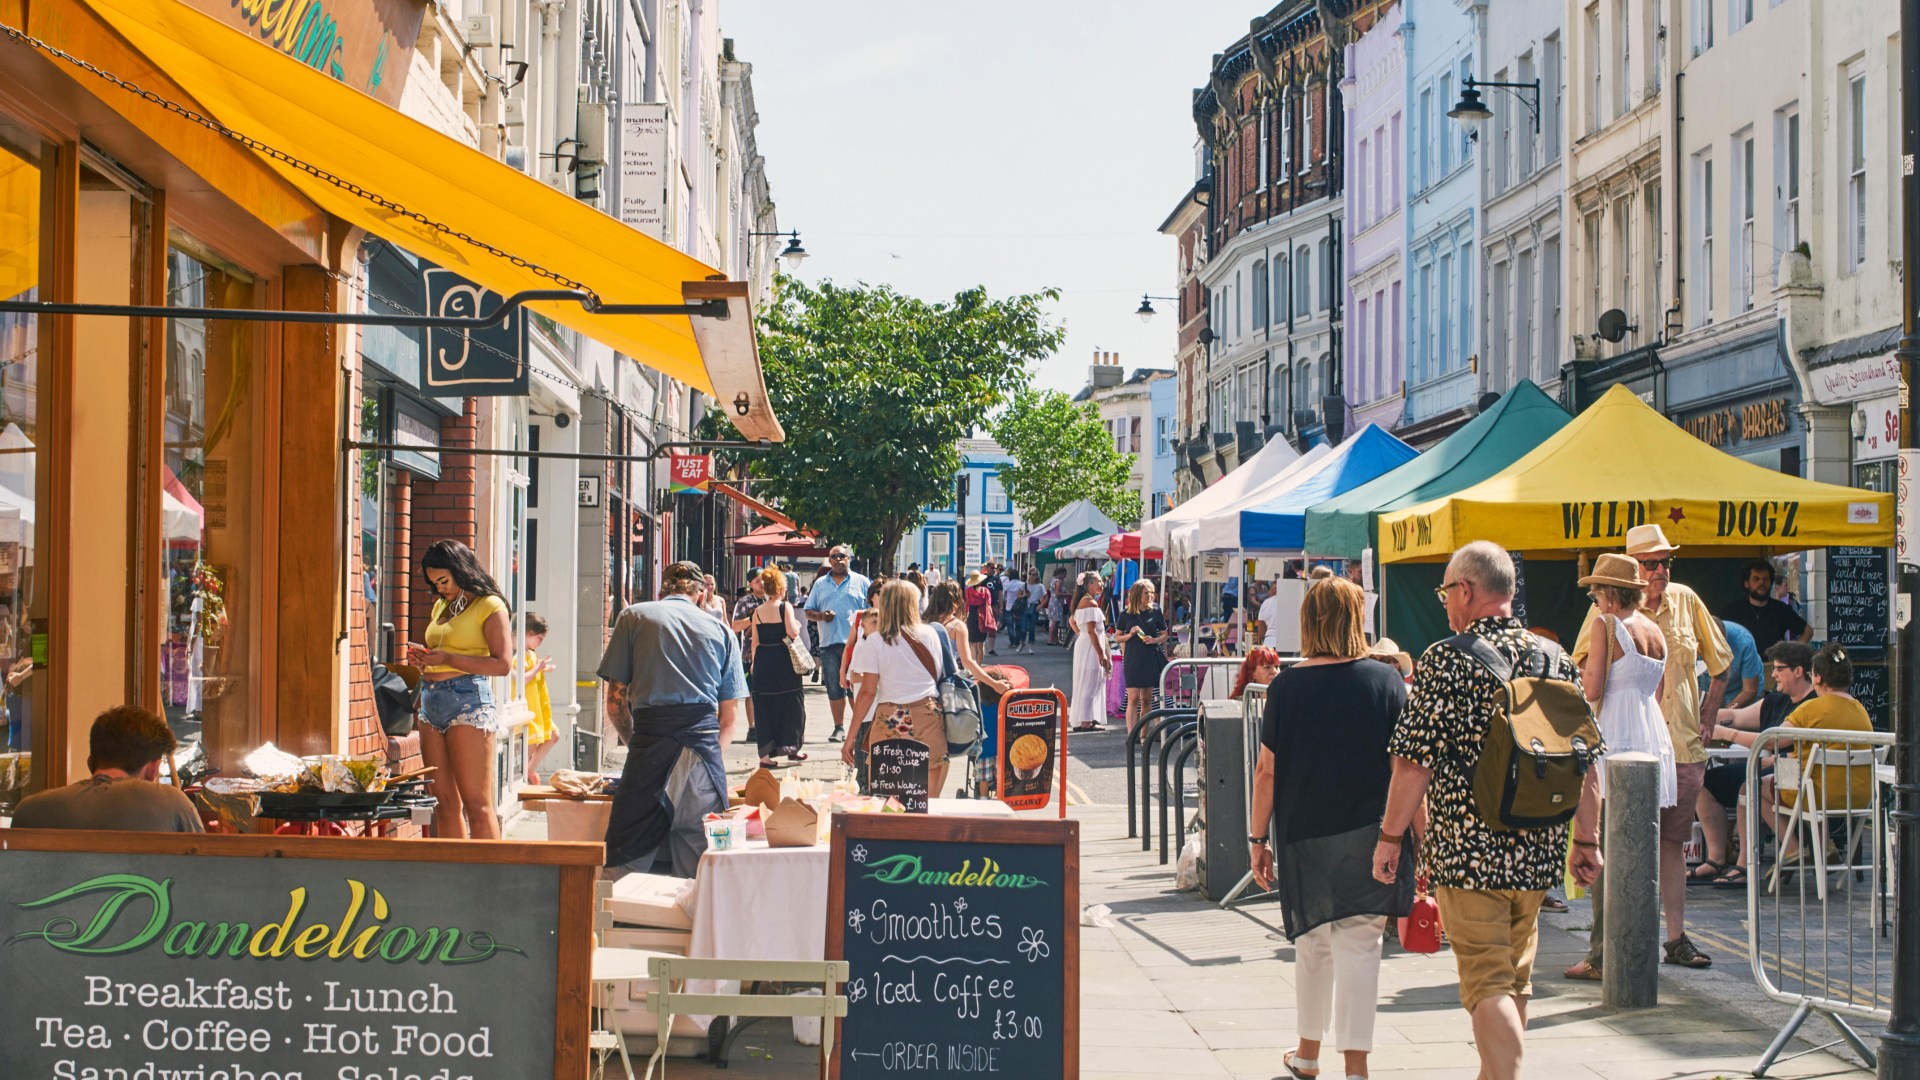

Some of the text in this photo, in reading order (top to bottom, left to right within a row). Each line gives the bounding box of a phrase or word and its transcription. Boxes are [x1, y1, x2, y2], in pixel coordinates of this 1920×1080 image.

[624, 197, 646, 206] Fully
[1824, 371, 1849, 394] Quality
[1849, 362, 1887, 389] Secondhand
[1742, 398, 1786, 441] BARBERS
[676, 458, 703, 470] JUST
[681, 469, 703, 479] EAT
[1561, 500, 1799, 539] WILD DOGZ
[883, 744, 930, 761] Fresh Orange
[880, 780, 896, 790] Fresh
[861, 853, 1049, 889] Dandelion
[10, 873, 525, 963] Dandelion
[870, 899, 1003, 945] Smoothies
[84, 975, 458, 1014] Breakfast Lunch
[873, 970, 1016, 1019] Iced Coffee
[35, 1017, 493, 1058] Tea Coffee Hot Food
[882, 1041, 1000, 1072] ORDER INSIDE
